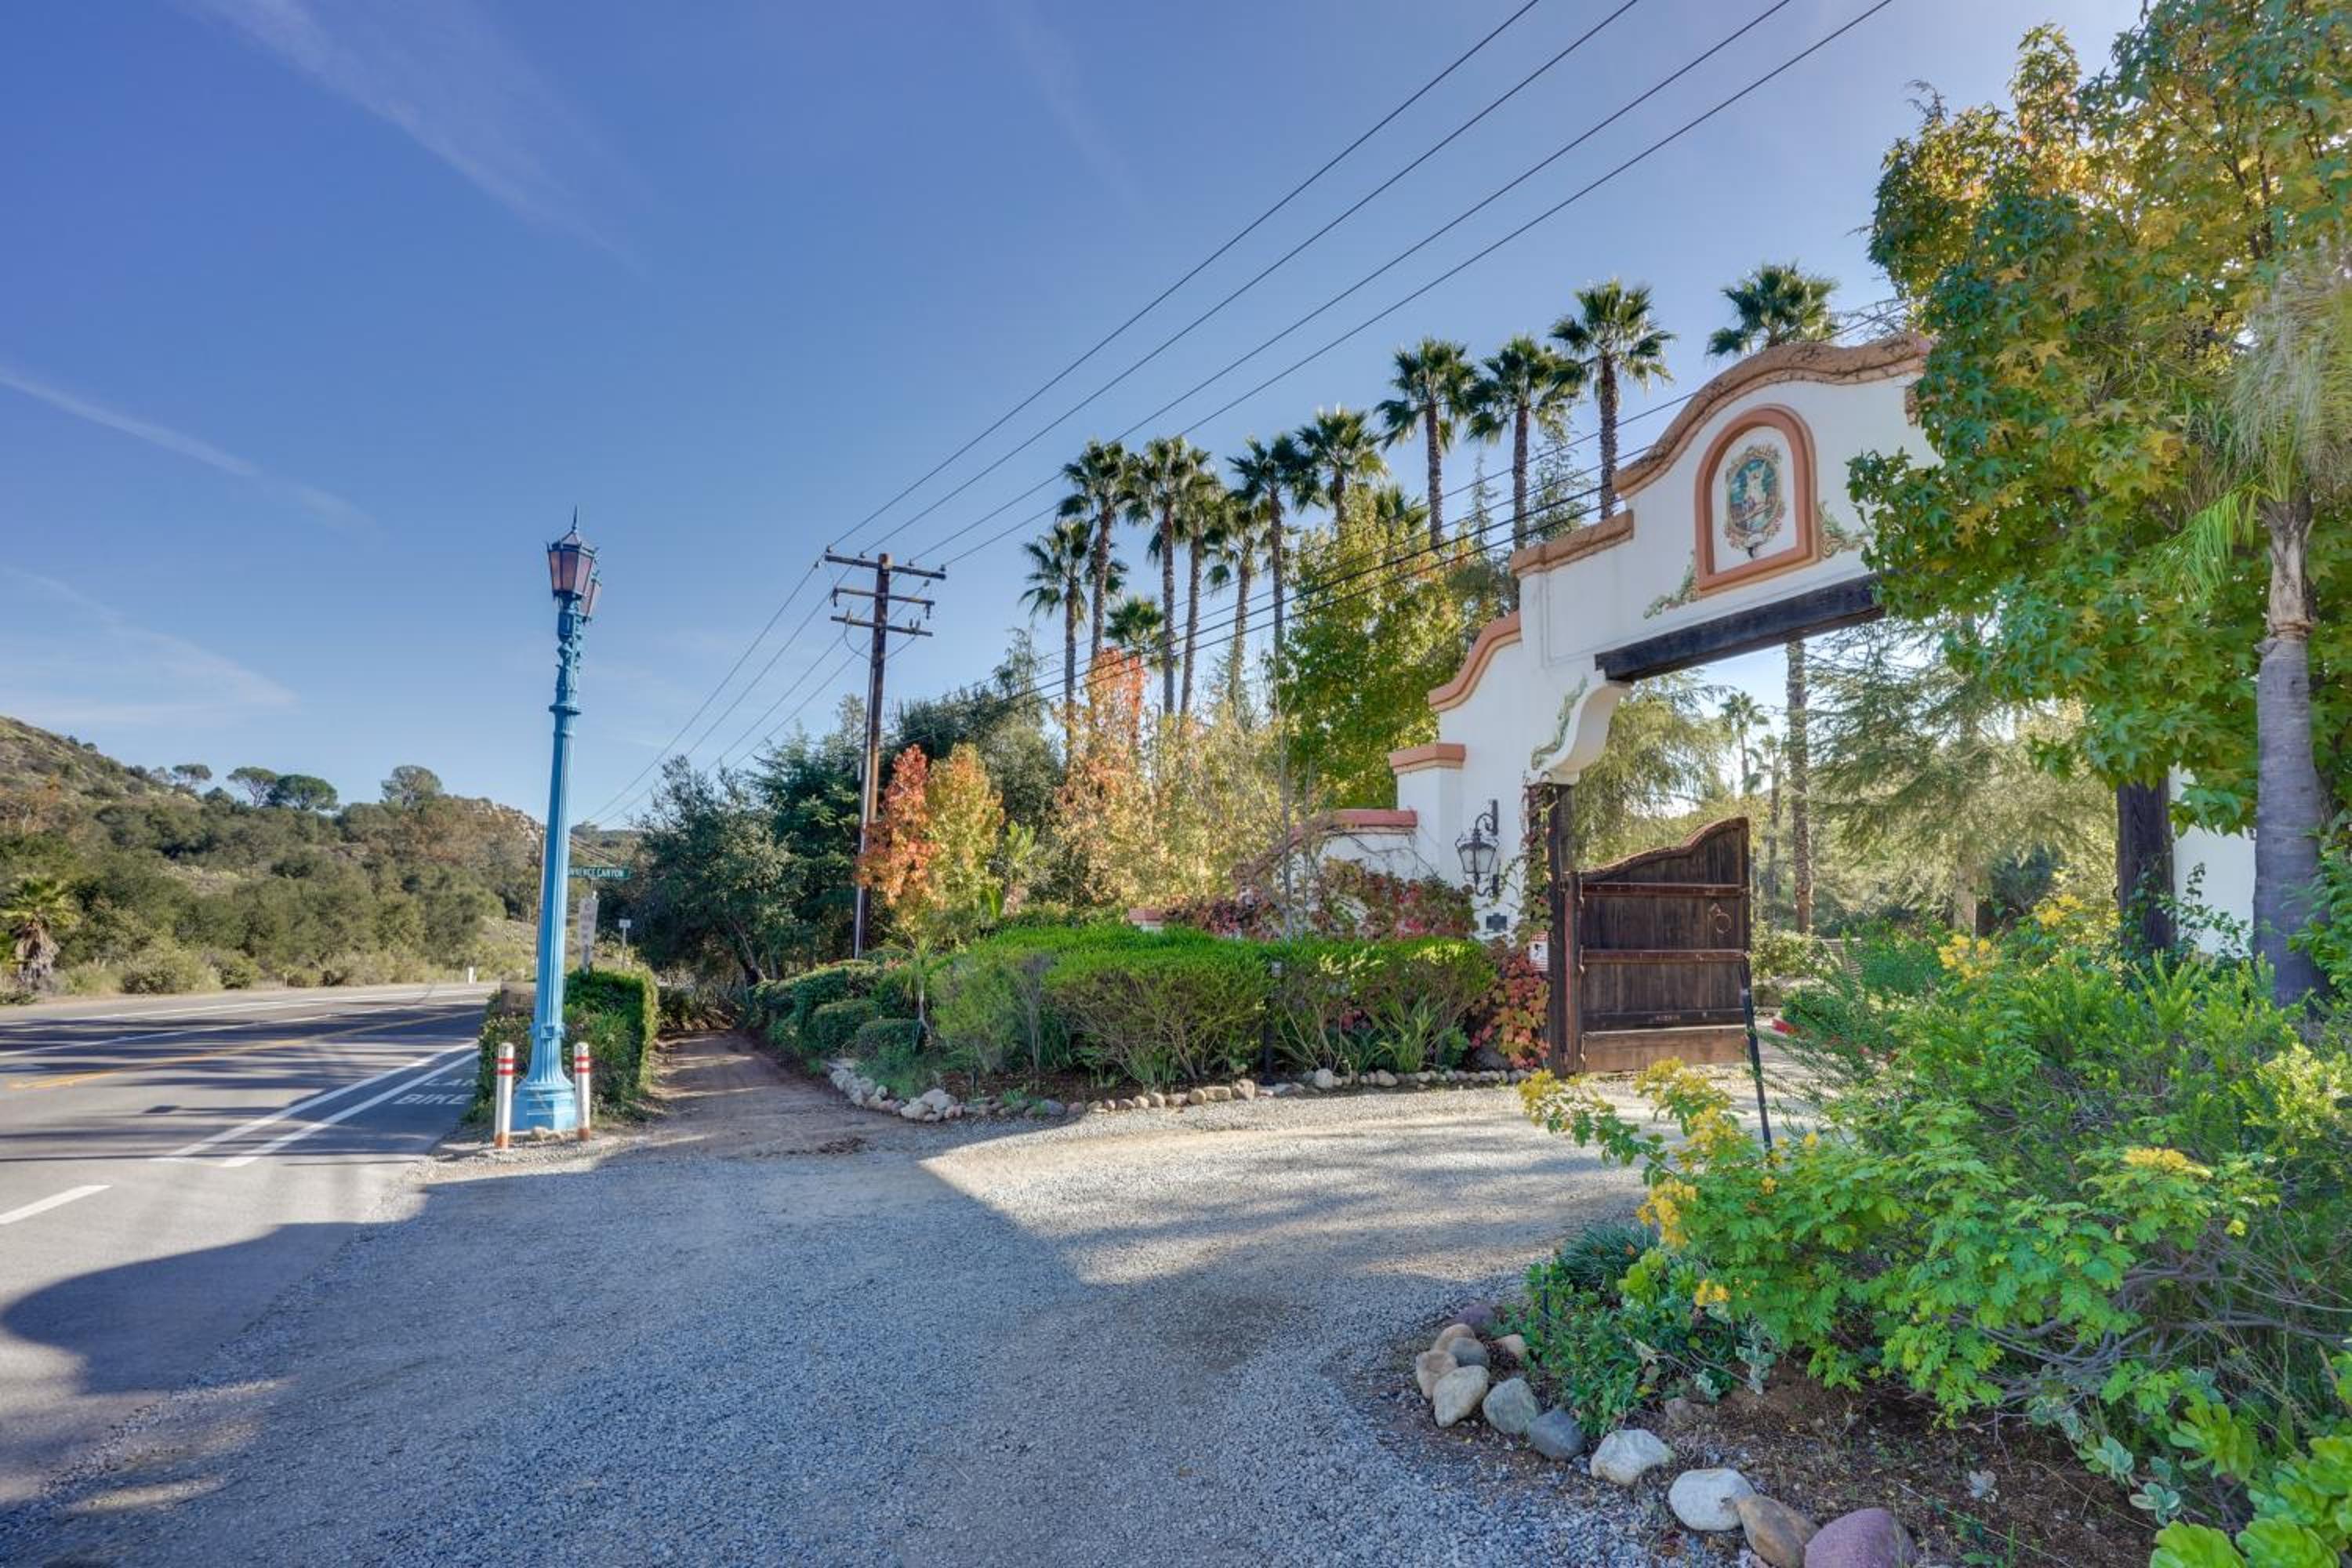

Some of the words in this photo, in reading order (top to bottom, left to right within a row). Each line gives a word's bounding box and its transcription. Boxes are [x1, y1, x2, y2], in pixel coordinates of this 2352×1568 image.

[569, 867, 596, 877] WRENCE
[597, 867, 624, 878] CANYON
[424, 1078, 477, 1087] LAN
[392, 1094, 477, 1105] BIKE
